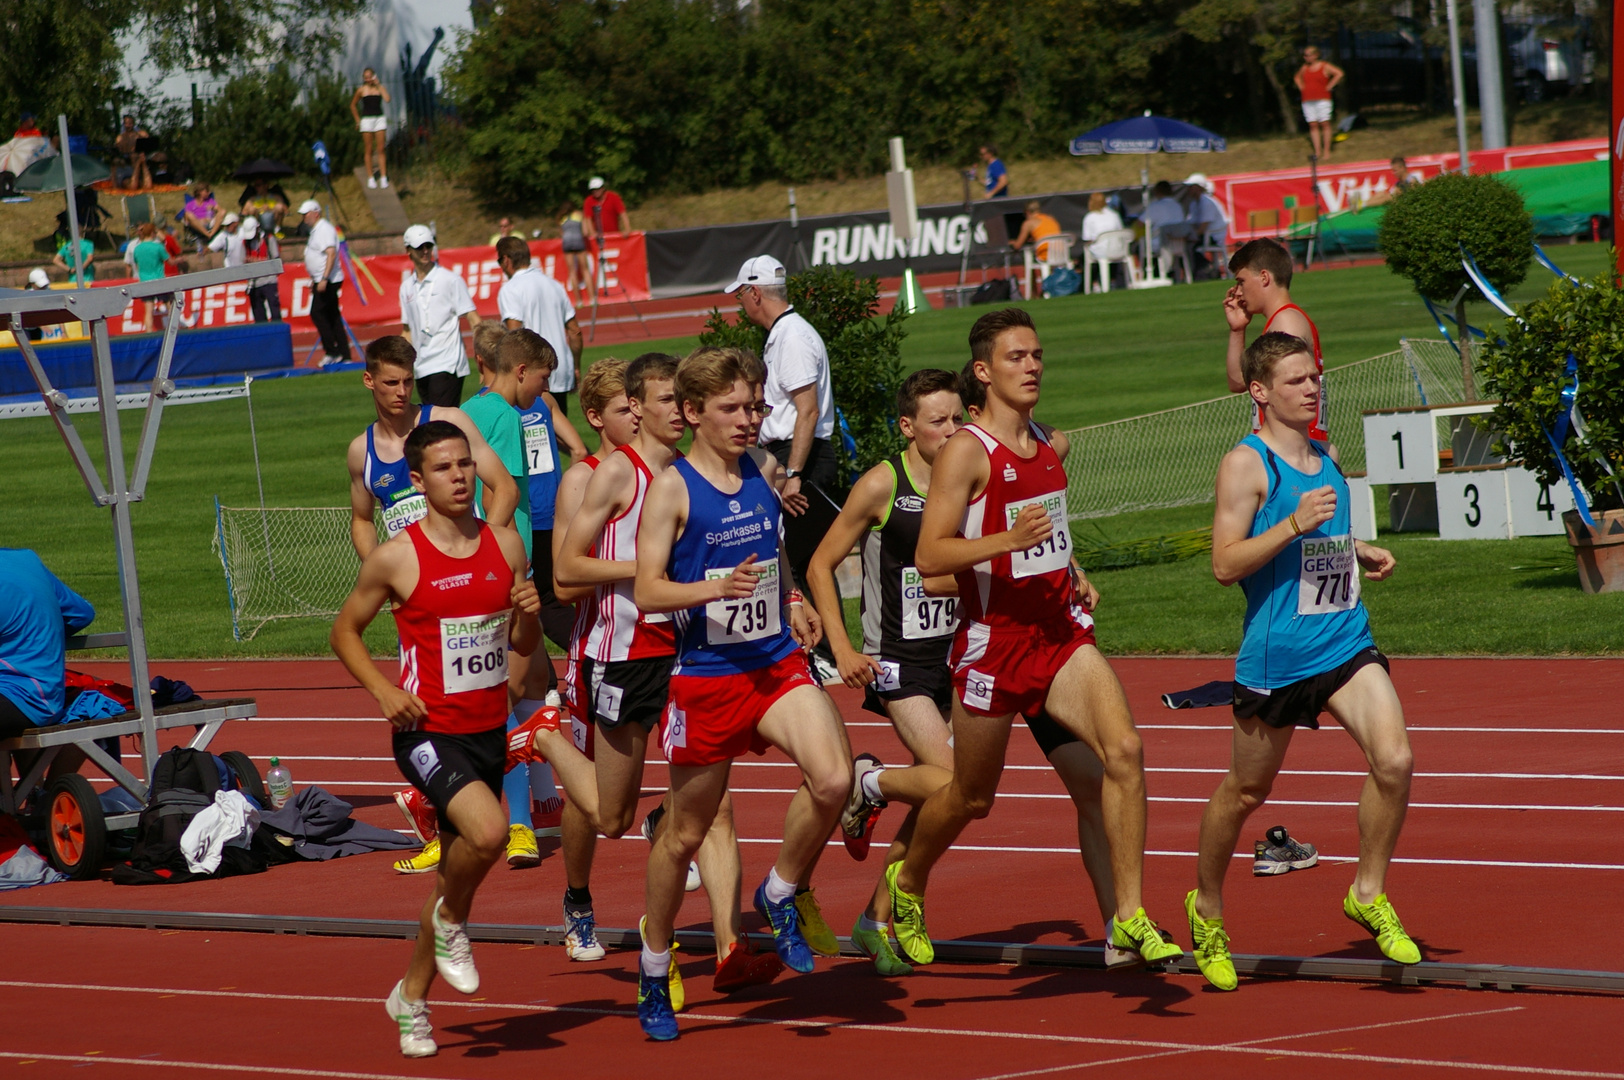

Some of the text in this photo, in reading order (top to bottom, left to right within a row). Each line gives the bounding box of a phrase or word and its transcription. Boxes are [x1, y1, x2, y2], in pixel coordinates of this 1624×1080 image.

[524, 427, 547, 438] MER
[1391, 431, 1404, 469] 1
[1463, 484, 1481, 527] 3
[1537, 484, 1555, 521] 4
[388, 515, 412, 532] GEK
[705, 522, 762, 545] Sparkasse
[1304, 556, 1335, 573] GEK
[439, 578, 470, 591] GLASER
[757, 579, 778, 591] gesund
[904, 586, 925, 600] GE
[1315, 571, 1351, 605] 770
[725, 599, 767, 636] 739
[917, 598, 955, 631] 979
[446, 614, 506, 636] BARMER
[446, 635, 480, 650] GEK
[451, 647, 504, 676] 1608
[882, 666, 893, 684] 2
[975, 681, 987, 698] 9
[606, 695, 614, 711] 1
[573, 728, 581, 742] 4
[672, 717, 683, 736] 8
[417, 750, 429, 766] 6
